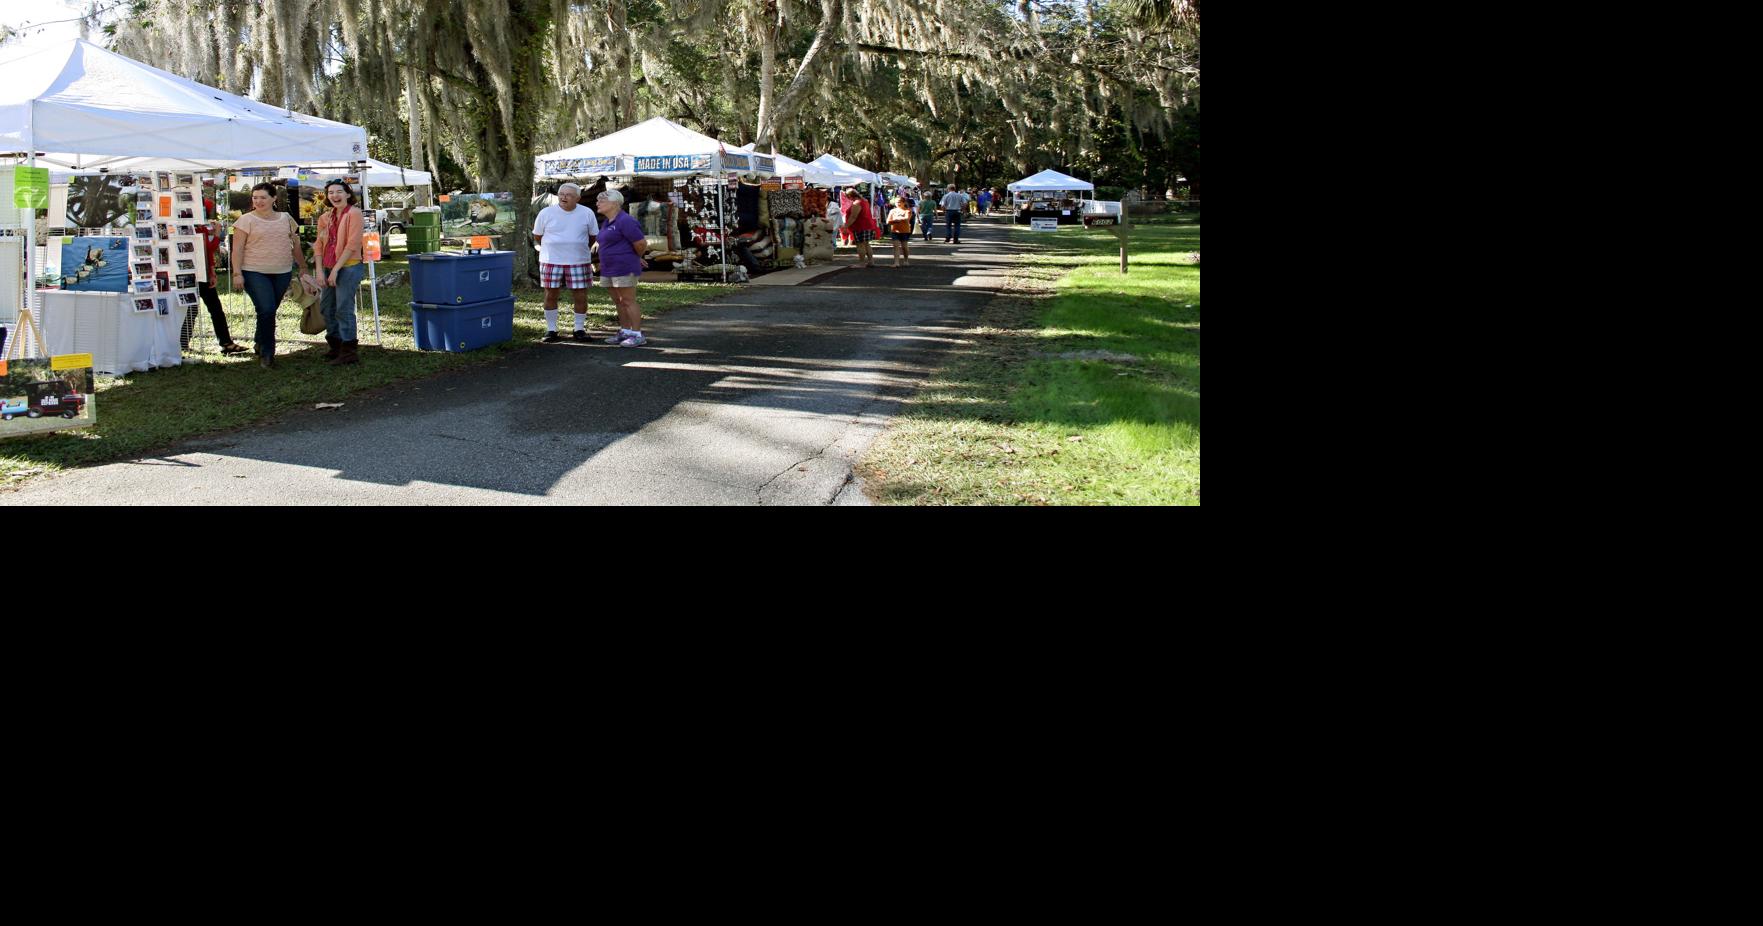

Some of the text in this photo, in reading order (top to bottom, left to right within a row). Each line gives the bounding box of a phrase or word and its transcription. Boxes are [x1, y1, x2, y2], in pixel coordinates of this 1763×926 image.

[638, 157, 688, 170] MADE IN USA
